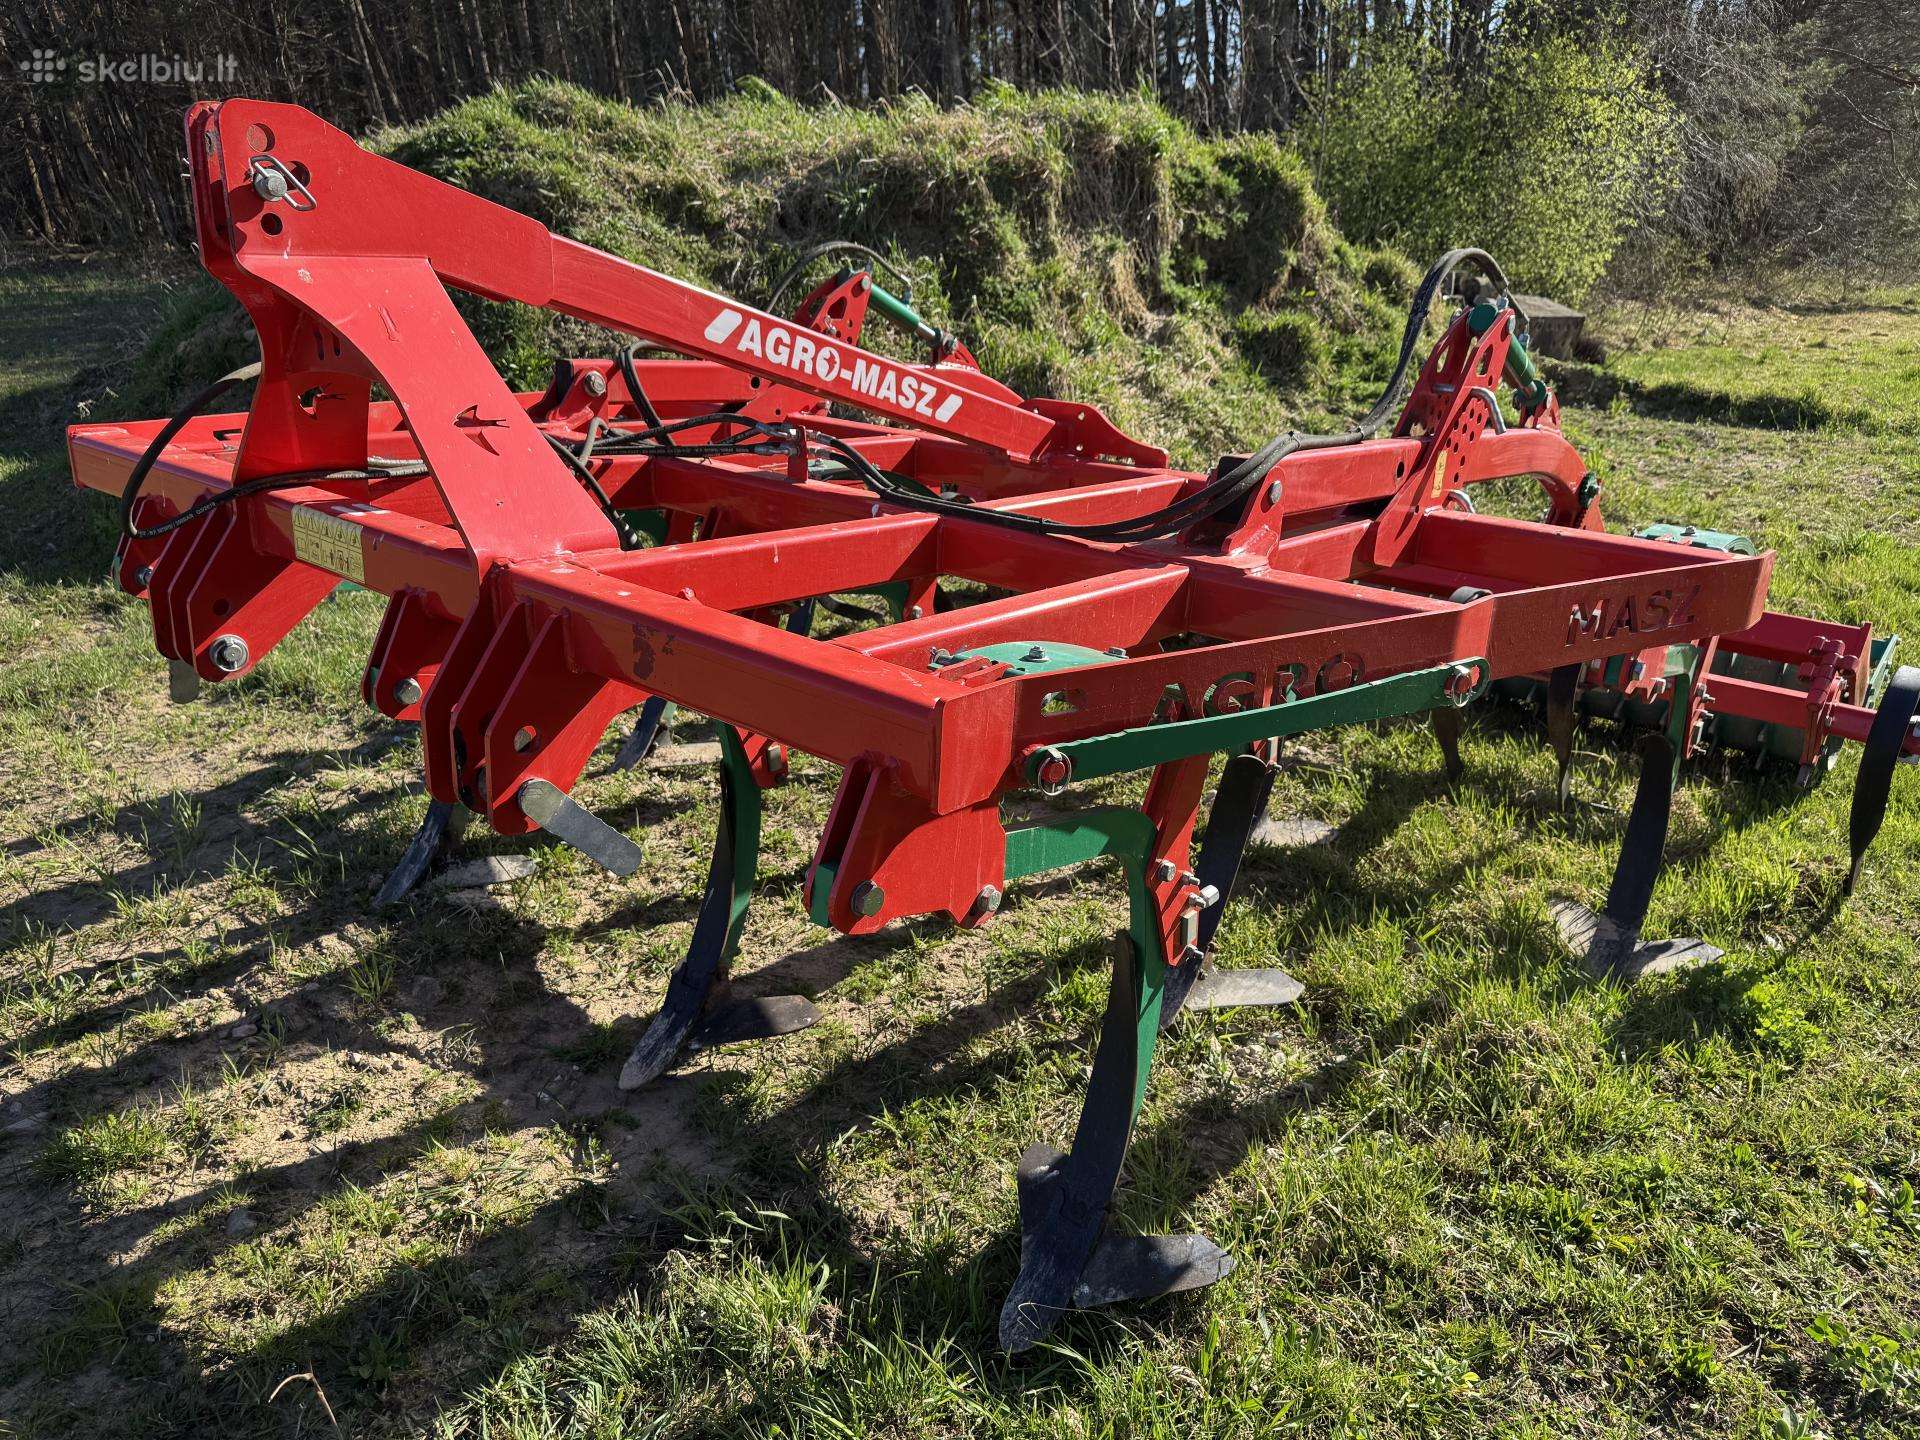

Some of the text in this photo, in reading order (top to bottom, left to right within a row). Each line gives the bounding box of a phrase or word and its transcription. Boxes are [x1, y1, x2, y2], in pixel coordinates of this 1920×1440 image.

[737, 318, 940, 417] AGRO-MASZ
[1147, 584, 1701, 726] AGRO MASZ
